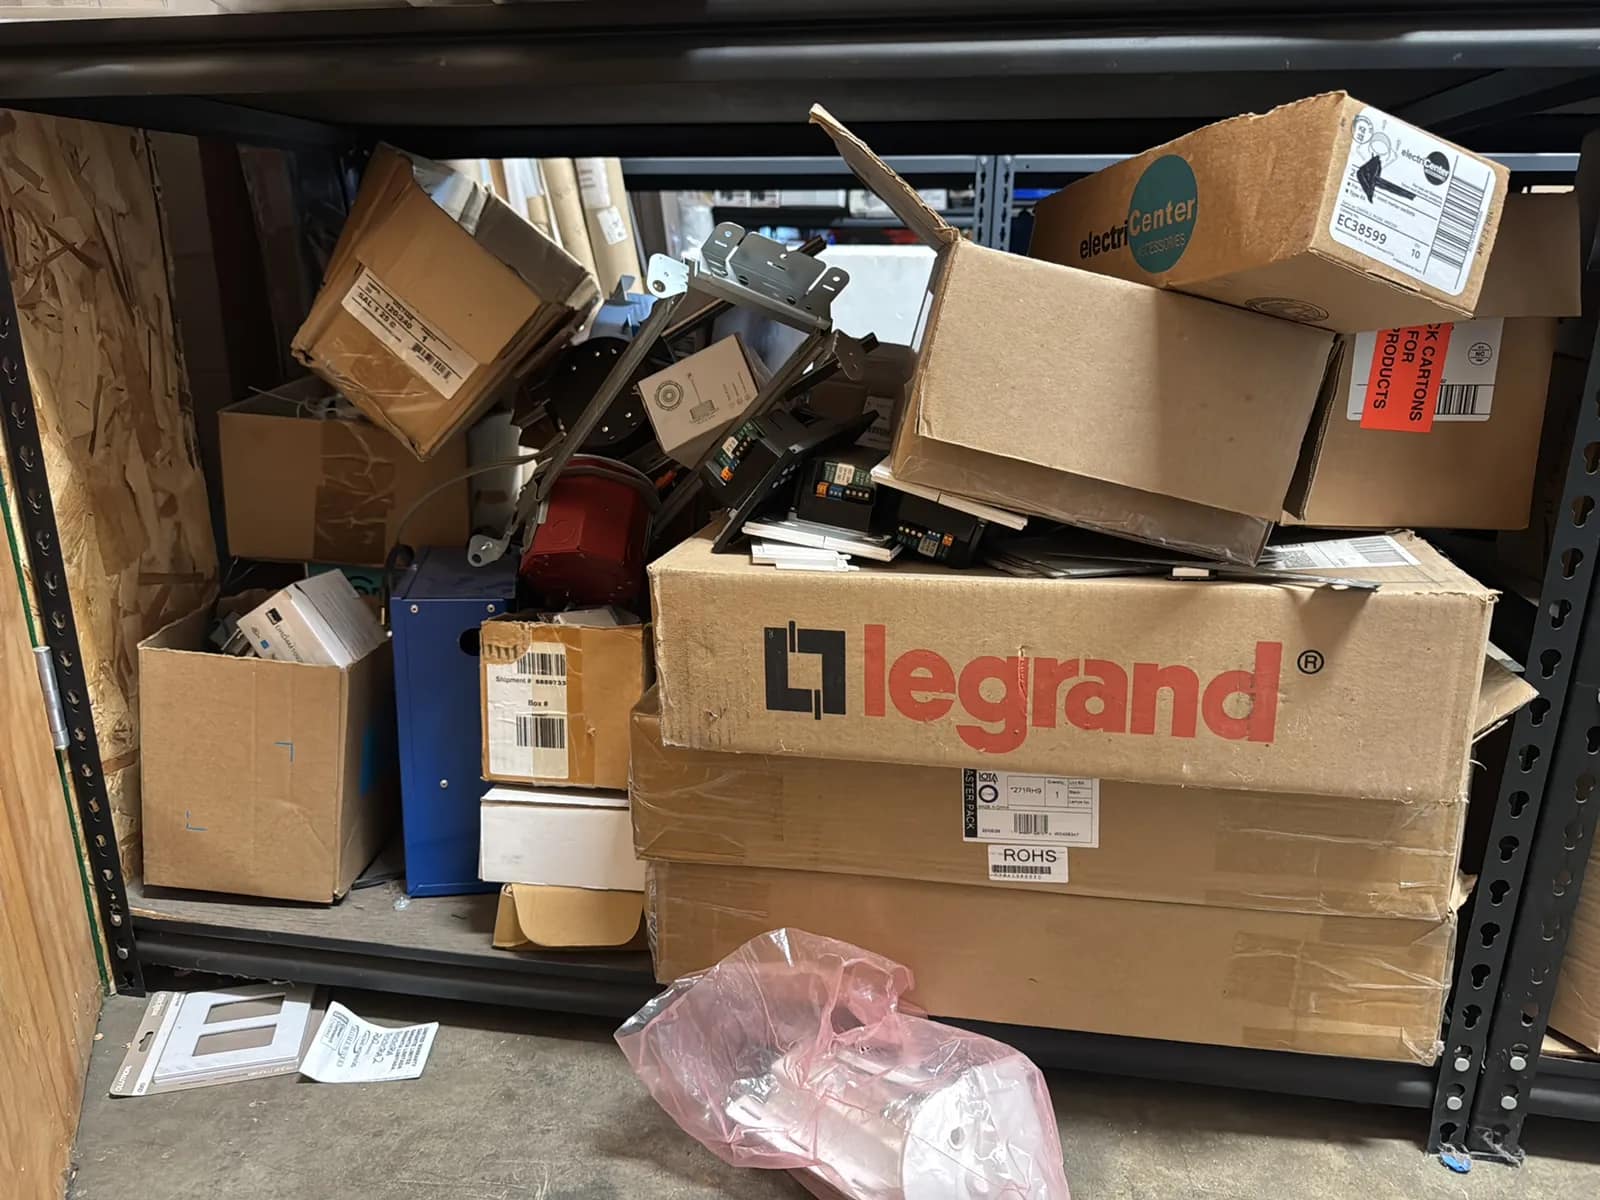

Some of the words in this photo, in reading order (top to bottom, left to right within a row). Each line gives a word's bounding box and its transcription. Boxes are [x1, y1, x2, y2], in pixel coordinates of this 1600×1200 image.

[1336, 213, 1388, 245] EC38599
[1410, 248, 1421, 259] 10
[1401, 330, 1420, 363] FOR
[1409, 346, 1436, 422] CARTONS
[527, 699, 542, 707] Box
[864, 624, 1283, 754] legrand
[964, 769, 976, 803] ASTER
[964, 804, 976, 831] PACK
[1003, 848, 1058, 863] ROHS
